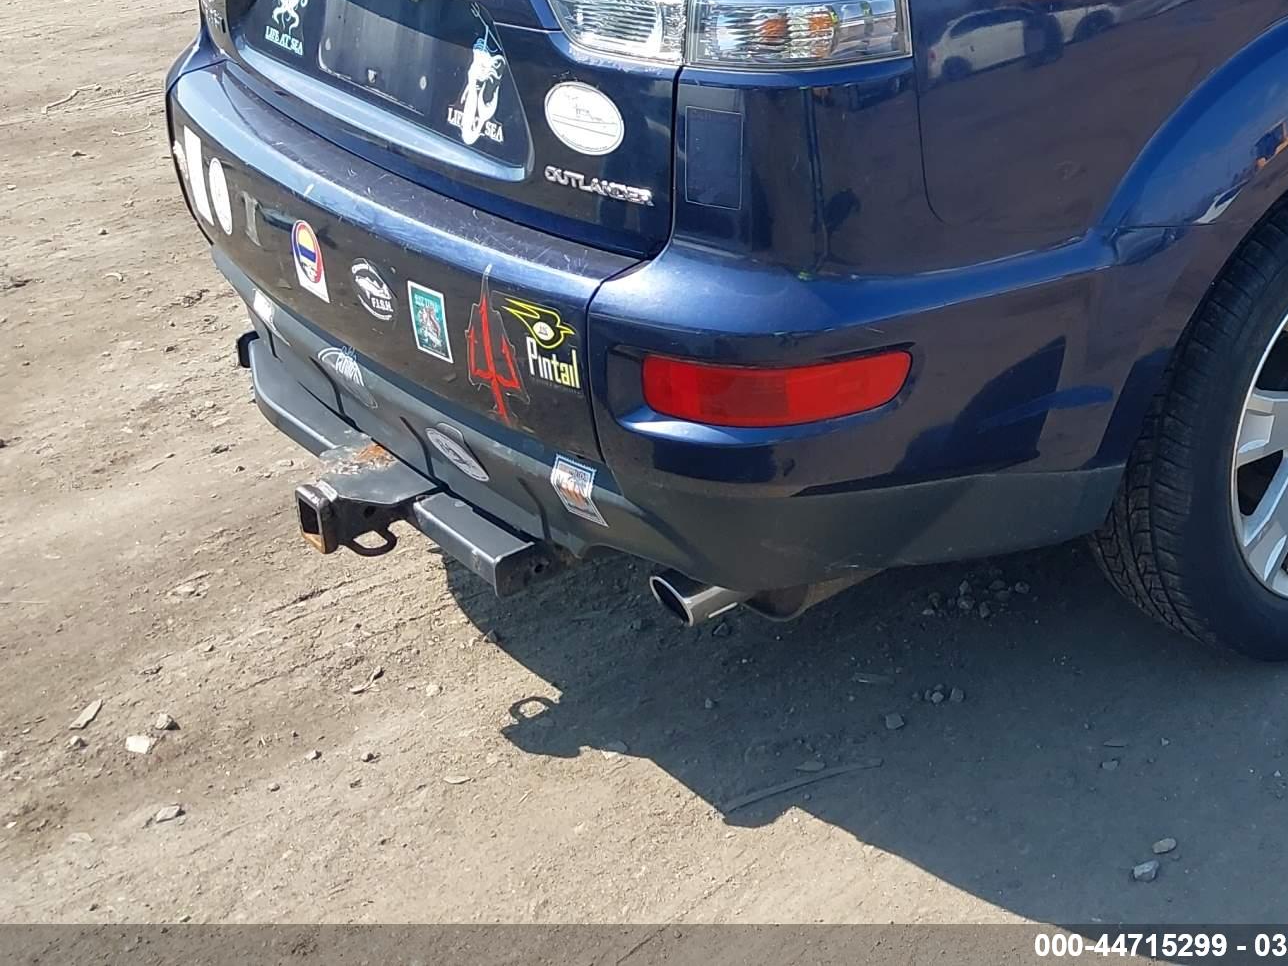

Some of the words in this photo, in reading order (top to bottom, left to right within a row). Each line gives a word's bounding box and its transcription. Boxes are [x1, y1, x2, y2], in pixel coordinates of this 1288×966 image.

[279, 33, 292, 50] AT
[290, 37, 304, 56] SEA
[484, 120, 504, 143] SEA
[544, 165, 655, 207] OUTLANDER
[526, 335, 580, 389] Pintail
